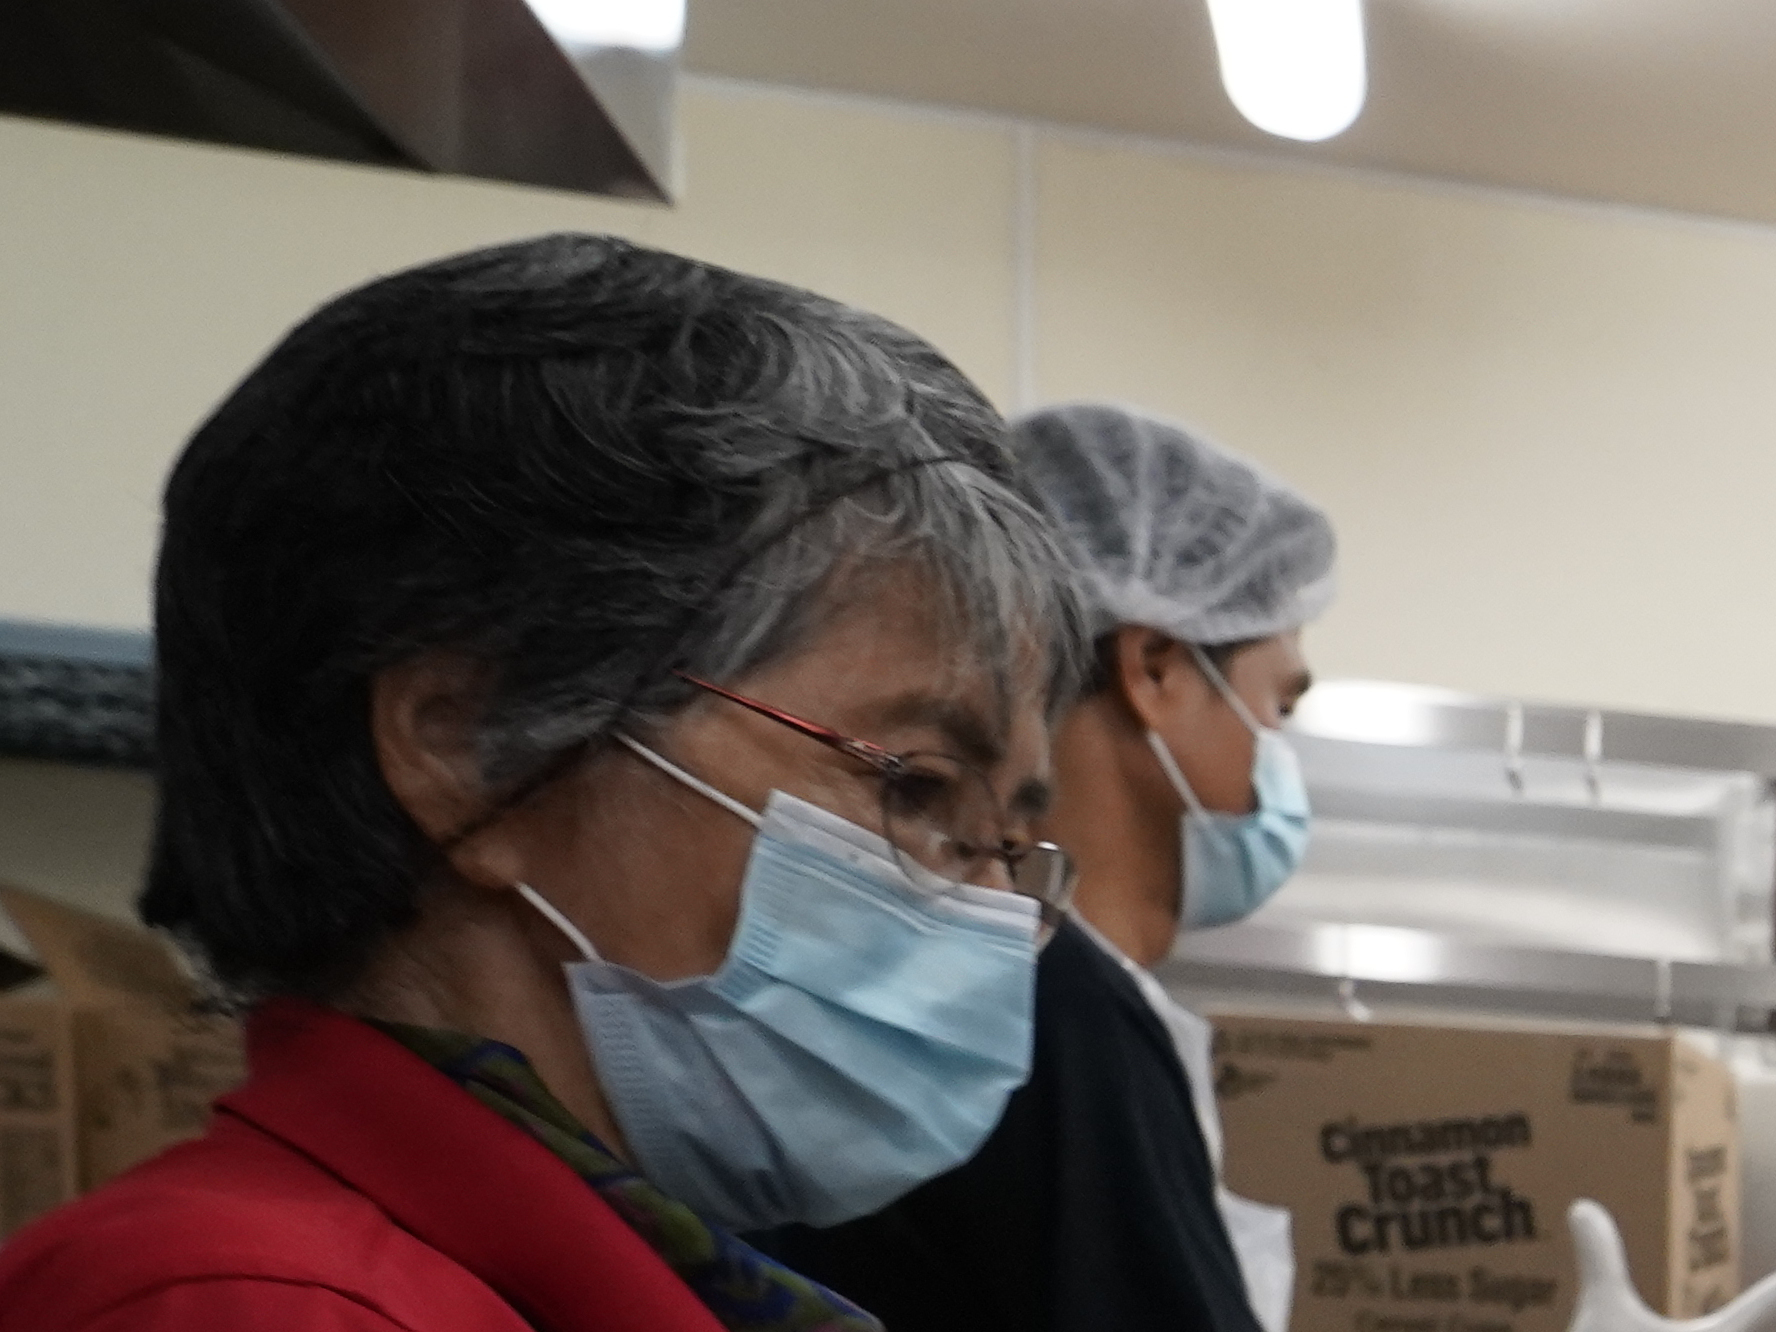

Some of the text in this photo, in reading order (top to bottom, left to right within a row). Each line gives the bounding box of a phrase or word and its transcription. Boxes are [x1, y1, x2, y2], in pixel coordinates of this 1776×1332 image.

[1319, 1112, 1531, 1164] Cinnamon
[1358, 1156, 1494, 1204] Toast
[1335, 1188, 1535, 1255] Crunch
[1311, 1262, 1557, 1312] 25% Less Sugar
